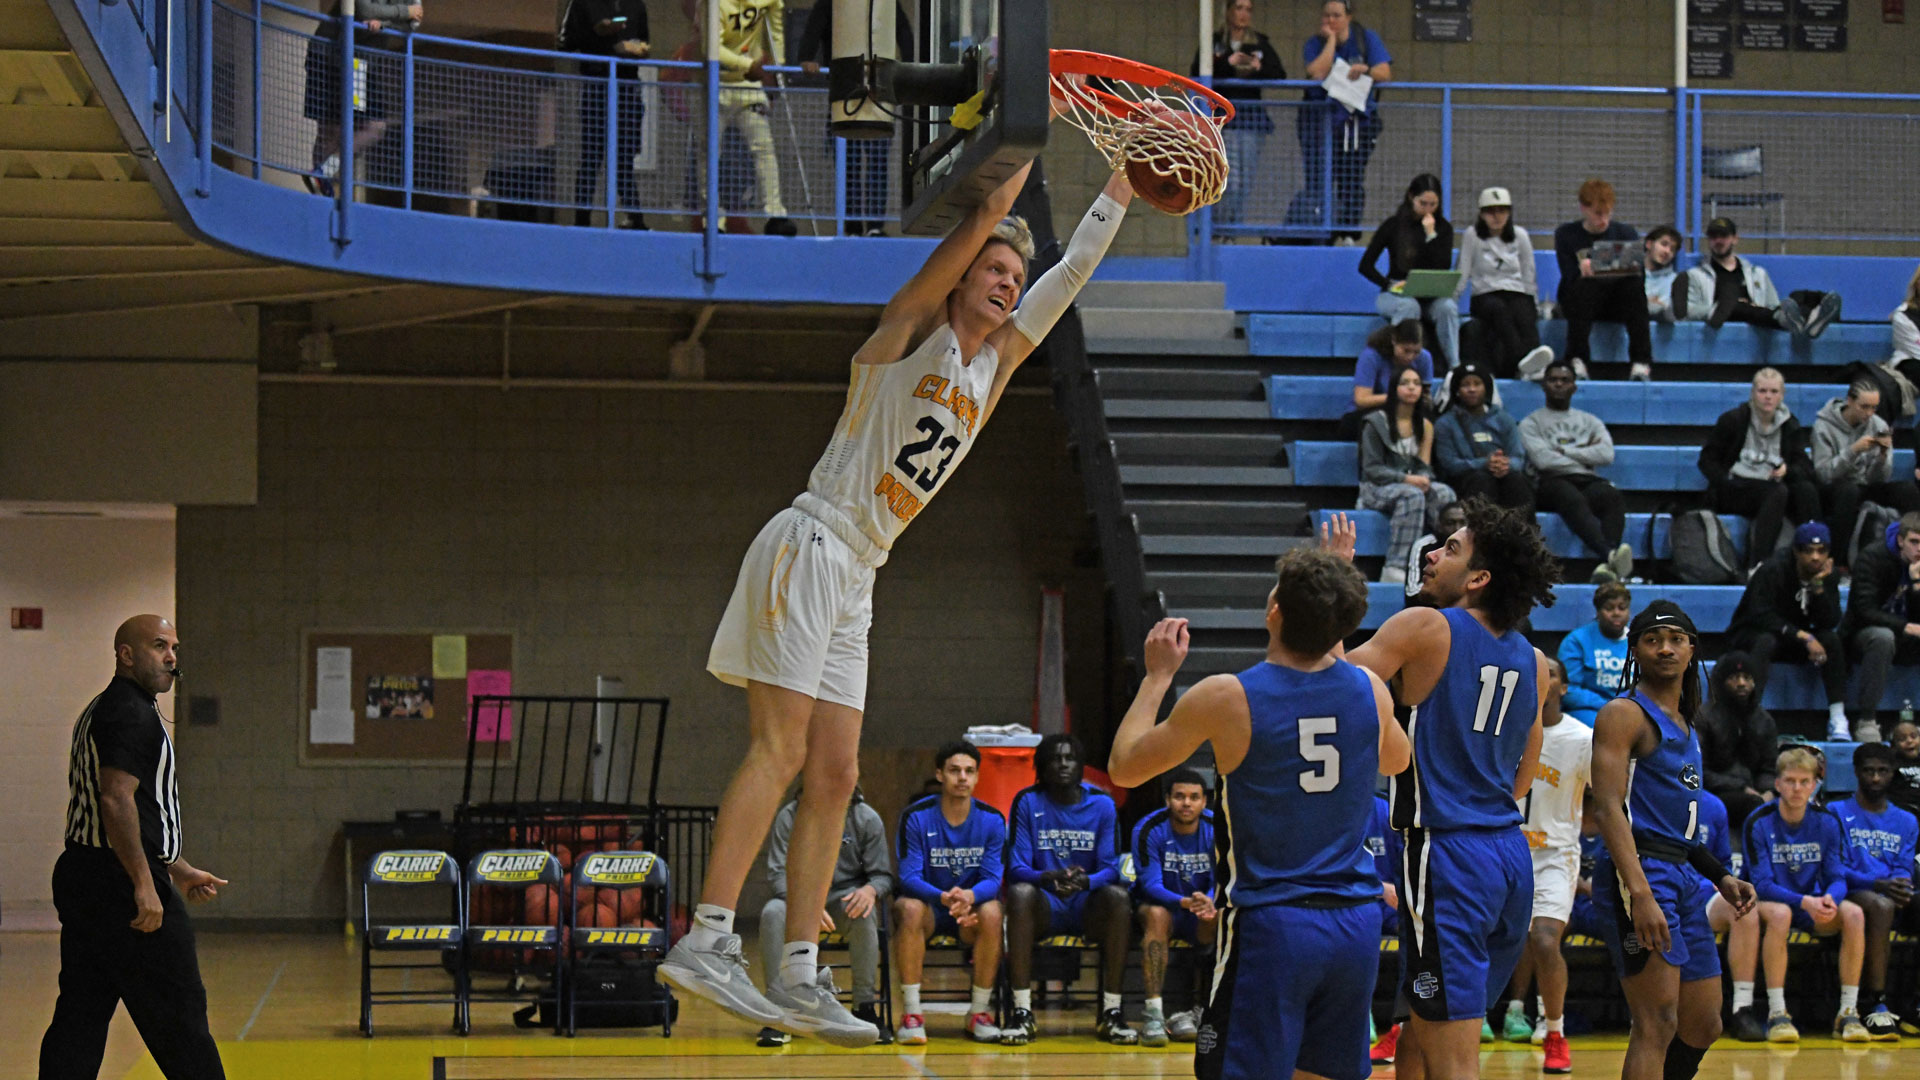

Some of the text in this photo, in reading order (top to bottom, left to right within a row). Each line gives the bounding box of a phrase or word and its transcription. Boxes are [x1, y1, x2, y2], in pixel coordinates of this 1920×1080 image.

[912, 374, 979, 440] CLARK
[894, 415, 961, 493] 23
[1472, 664, 1520, 736] 11
[1297, 715, 1341, 794] 5
[1684, 800, 1698, 840] 1
[378, 855, 443, 873] CLARKE
[481, 855, 545, 873] CLARKE
[587, 857, 652, 875] CLARKE
[395, 872, 426, 880] PRIDE
[501, 871, 529, 879] PRIDE
[386, 928, 452, 941] PRIDE
[482, 929, 547, 942] PRIDE
[587, 931, 652, 945] PRIDE
